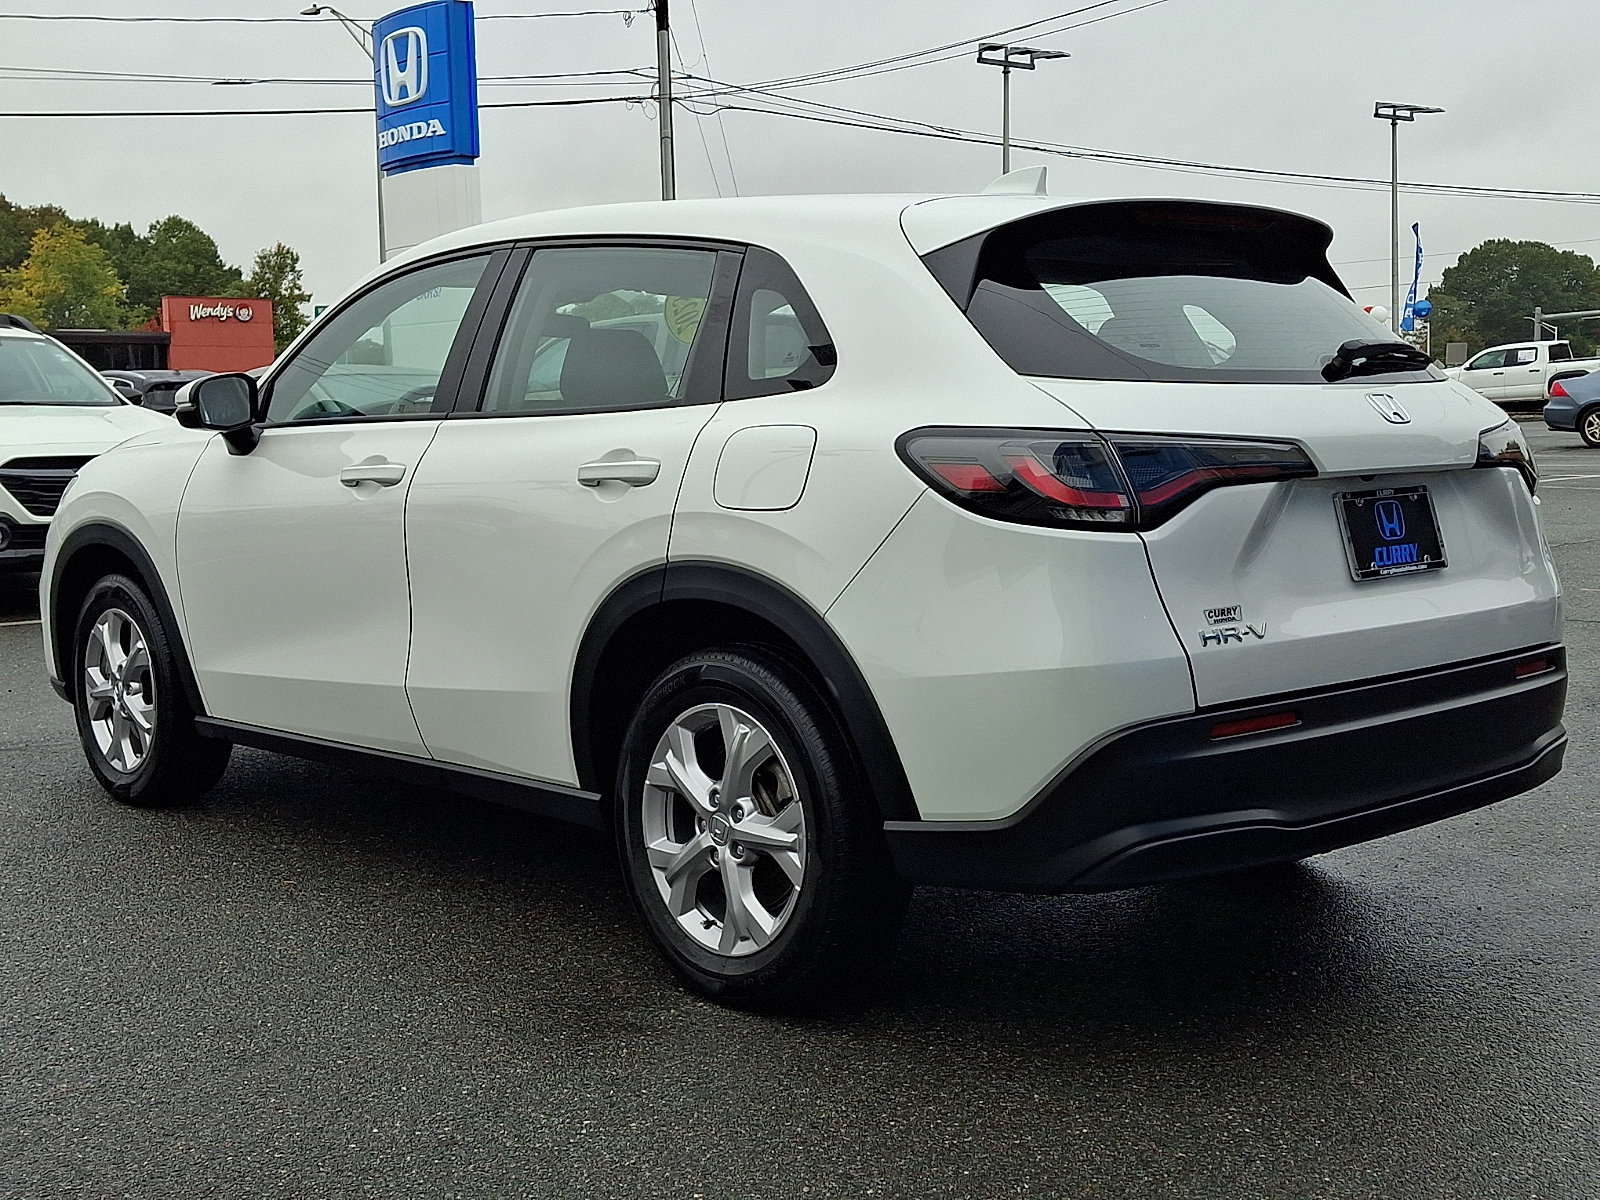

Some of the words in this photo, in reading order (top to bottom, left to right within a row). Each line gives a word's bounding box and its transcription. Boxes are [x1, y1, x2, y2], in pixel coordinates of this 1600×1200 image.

[378, 119, 446, 149] HONDA
[190, 302, 233, 320] Wendy's
[1376, 489, 1395, 497] CURRY
[1374, 543, 1417, 567] CURRY
[1208, 606, 1237, 619] CURRY
[1213, 616, 1237, 624] HONDA
[1198, 622, 1267, 647] HR-V
